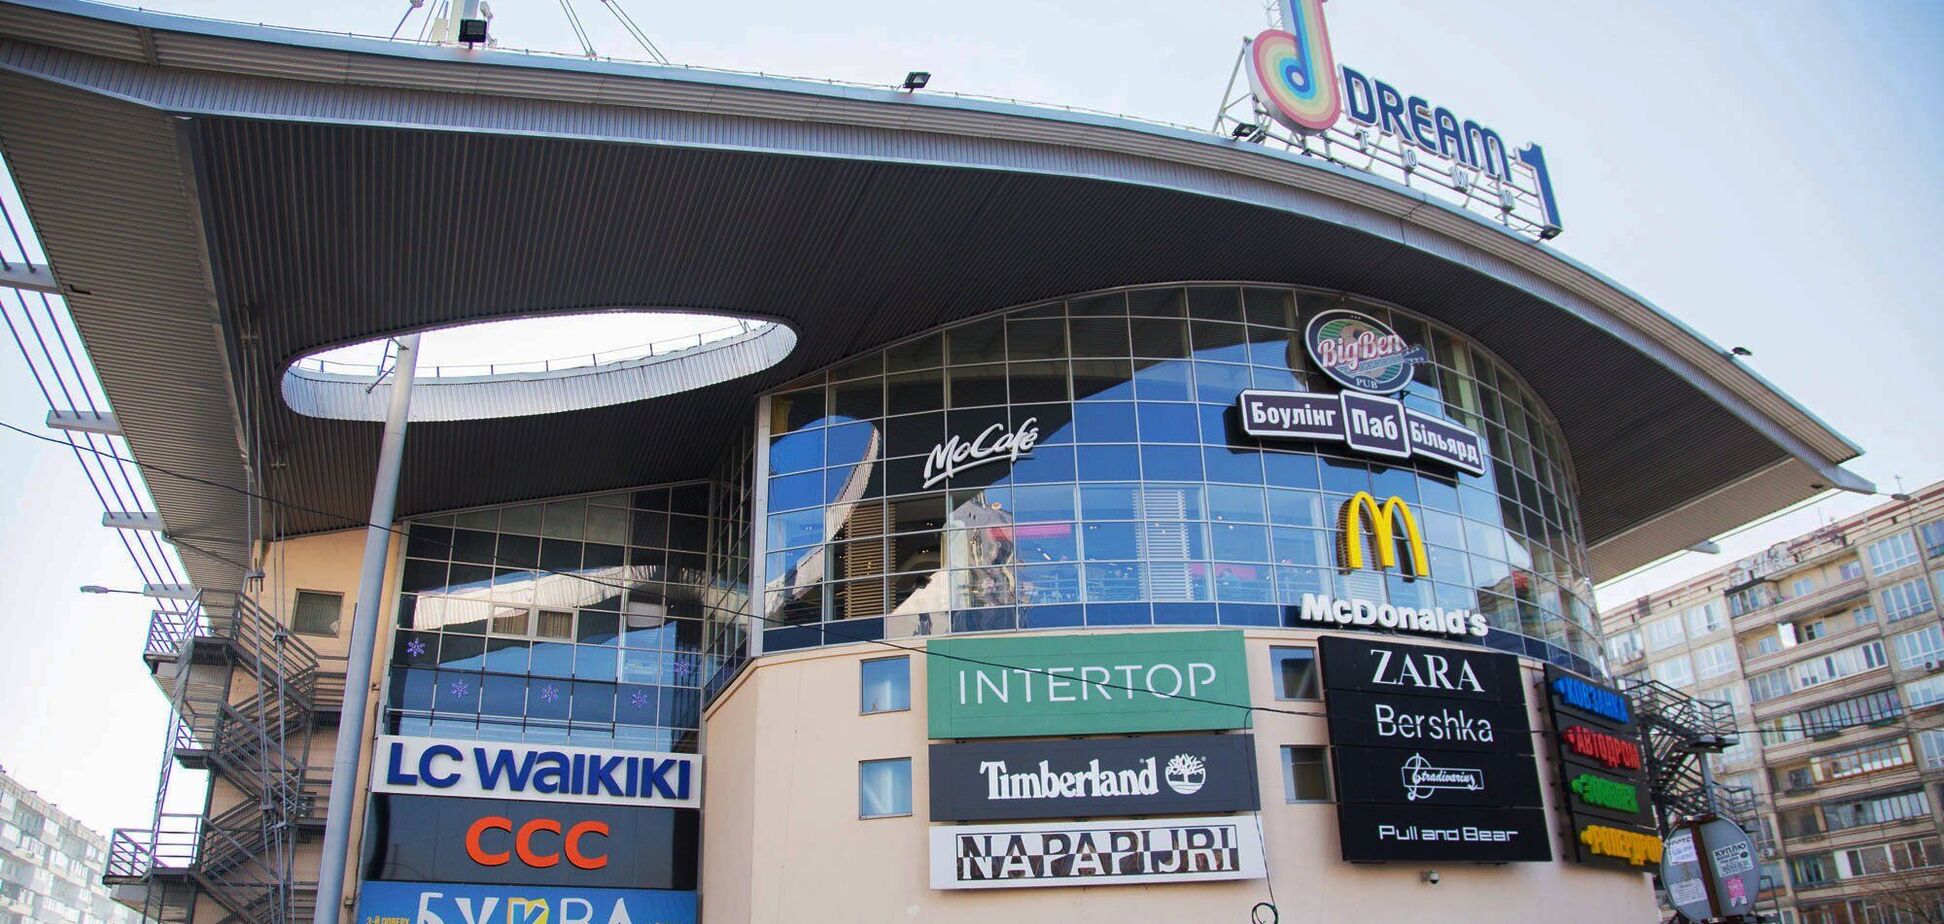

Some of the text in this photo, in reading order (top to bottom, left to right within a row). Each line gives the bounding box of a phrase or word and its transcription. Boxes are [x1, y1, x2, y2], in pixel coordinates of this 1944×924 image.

[1339, 64, 1513, 183] DREAM
[1355, 378, 1378, 389] PUB
[923, 417, 1039, 486] McCafé
[1251, 402, 1480, 465] Боулінг Паб Більярд
[1300, 593, 1489, 637] McDonald's
[959, 663, 1217, 704] INTERTOP
[1370, 649, 1486, 692] ZARA
[1375, 704, 1493, 743] Bershka
[387, 742, 464, 788] LC
[1574, 728, 1641, 769] АВТОДРОМ
[980, 757, 1159, 799] Timberland
[465, 816, 609, 870] CCC
[960, 827, 1235, 879] NAPAPIJRI
[1378, 825, 1518, 842] Pull and Bear
[1714, 842, 1746, 857] КУПЛЮ
